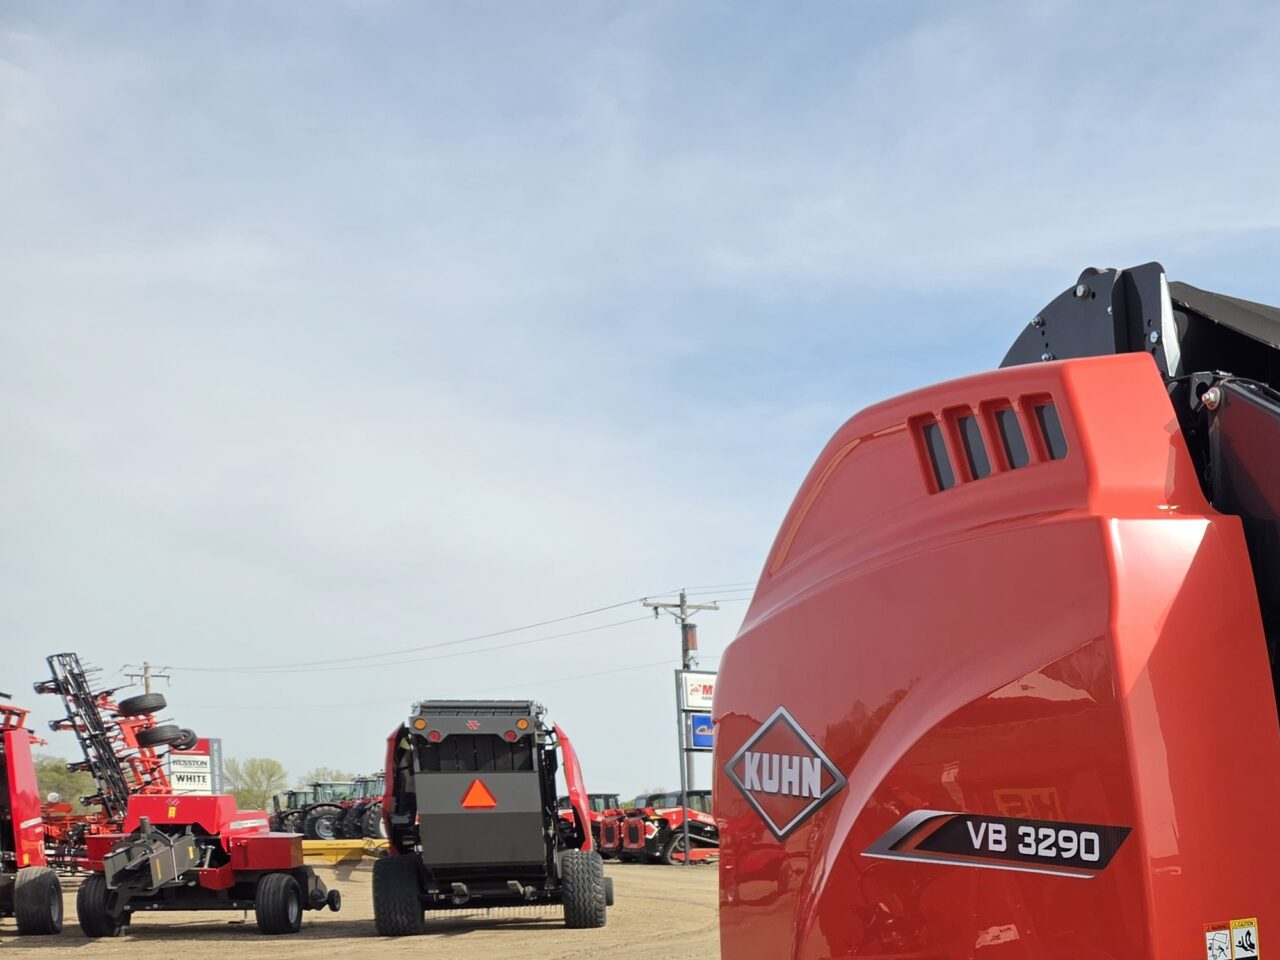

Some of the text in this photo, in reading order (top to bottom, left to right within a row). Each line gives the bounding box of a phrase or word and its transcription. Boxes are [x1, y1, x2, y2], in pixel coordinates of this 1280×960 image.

[745, 751, 821, 799] KUHN
[966, 820, 1100, 862] VB 3290
